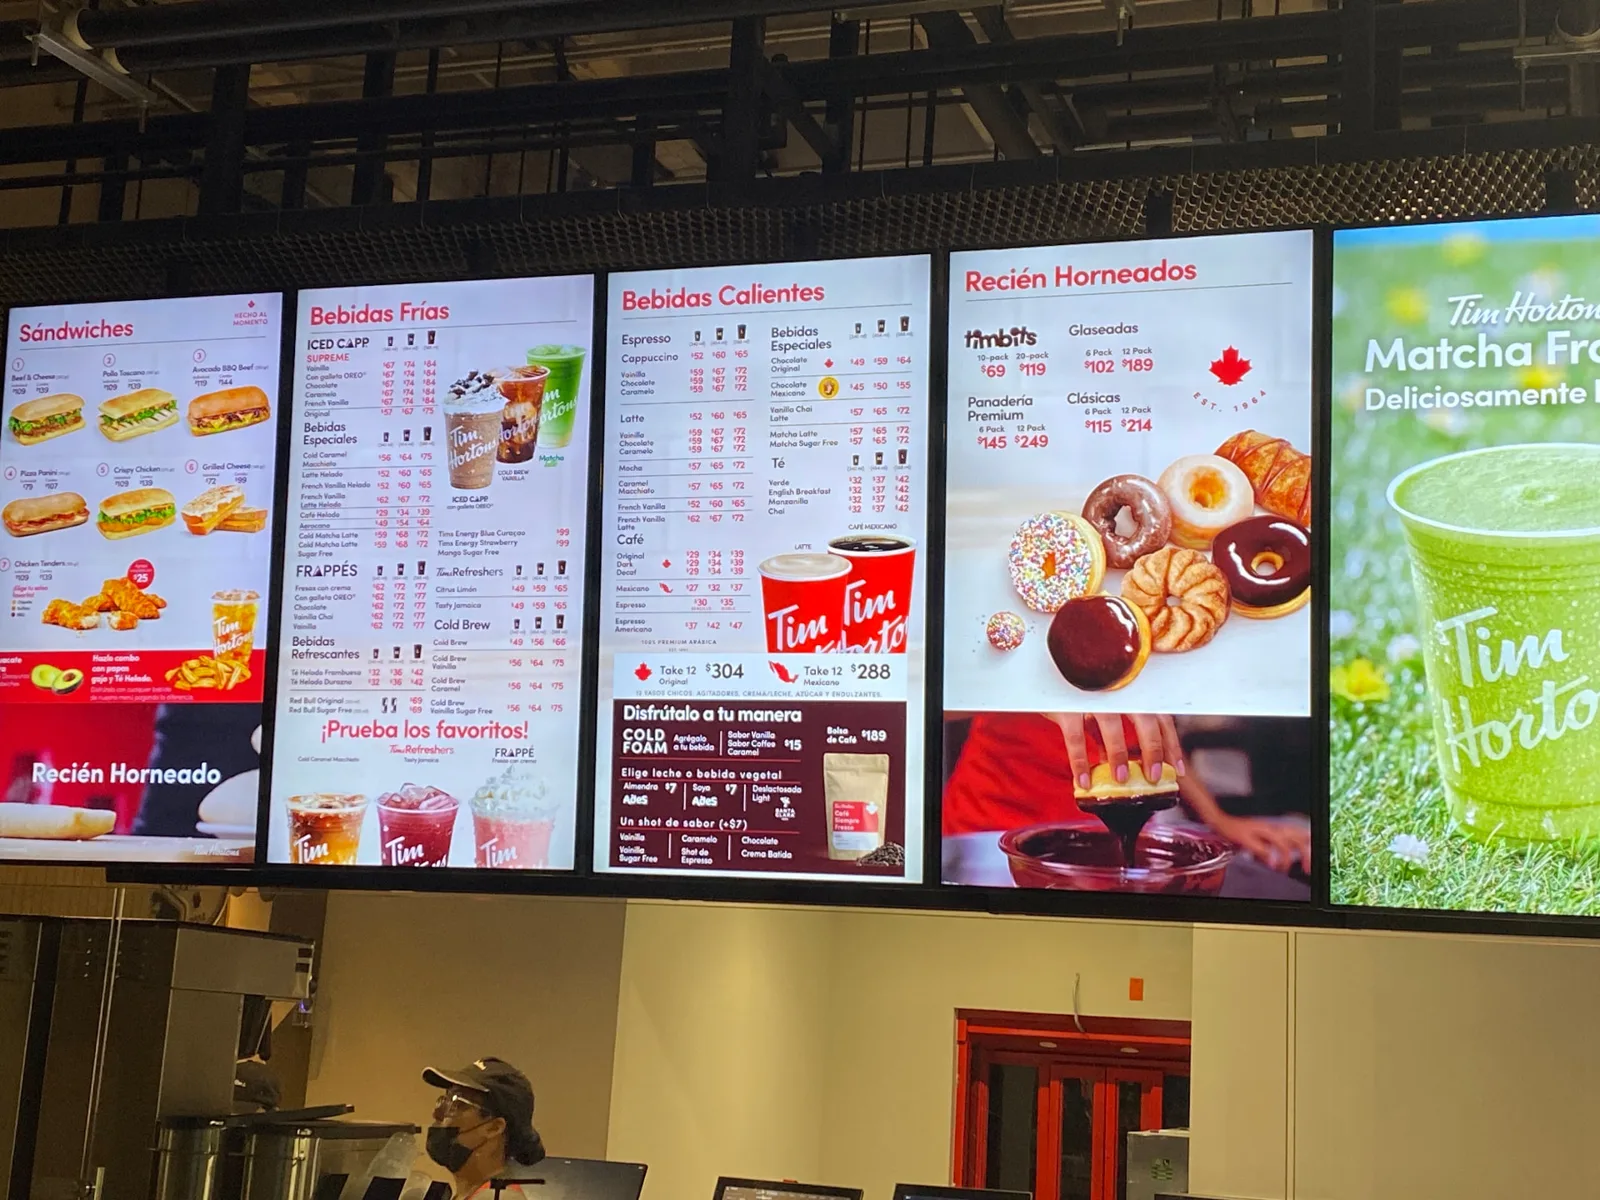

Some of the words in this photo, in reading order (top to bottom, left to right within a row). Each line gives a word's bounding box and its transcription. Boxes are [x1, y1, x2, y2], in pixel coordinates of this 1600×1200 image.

[965, 267, 1047, 292] Recién
[1055, 259, 1197, 287] Horneados
[623, 287, 712, 310] Bebidas
[719, 283, 826, 305] Calientes
[310, 303, 394, 325] Bebidas
[400, 300, 450, 321] Frías
[1448, 294, 1501, 326] Tim
[233, 318, 268, 326] MOMENTO
[19, 320, 134, 342] Sándwiches
[771, 326, 818, 338] Bebidas
[1069, 322, 1138, 336] Glaseadas
[622, 334, 671, 346] Espresso
[965, 326, 1037, 349] timbits
[308, 340, 334, 350] ICED
[771, 340, 832, 353] Especiales
[307, 353, 349, 362] SUPREME
[622, 353, 678, 365] Cappuccino
[691, 352, 704, 360] $52
[735, 350, 748, 358] $65
[977, 354, 1009, 362] 10-pack
[1016, 352, 1049, 360] 20-pack
[1365, 333, 1532, 372] Matcha
[851, 358, 865, 366] $49
[874, 357, 888, 365] $59
[897, 356, 911, 364] $64
[1084, 360, 1114, 374] $102
[1122, 358, 1153, 372] $189
[103, 369, 118, 377] Pollo
[192, 365, 221, 373] Avocado
[771, 365, 800, 373] Original
[981, 364, 1006, 378] $69
[1019, 362, 1046, 376] $119
[12, 374, 28, 382] Beef
[968, 394, 1033, 408] Panadería
[1067, 392, 1120, 405] Clásicas
[1365, 383, 1587, 411] Deliciosamente
[620, 415, 644, 423] Latte
[690, 412, 702, 420] $52
[968, 409, 1024, 421] Premium
[304, 422, 346, 433] Bebidas
[1085, 420, 1112, 433] $115
[1121, 419, 1152, 432] $214
[304, 434, 357, 447] Especiales
[977, 436, 1007, 449] $145
[1014, 434, 1049, 448] $249
[772, 457, 785, 468] Té
[20, 470, 36, 478] Pizza
[114, 466, 133, 474] Crispy
[769, 488, 794, 496] English
[617, 534, 644, 545] Café
[14, 560, 39, 568] Chicken
[296, 560, 358, 577] FRAPPÉS
[133, 574, 148, 582] $25
[214, 616, 240, 636] Tim
[434, 619, 459, 630] Cold
[462, 620, 490, 630] Brew
[768, 604, 828, 651] Tim
[292, 636, 335, 646] Bebidas
[1435, 606, 1570, 688] Tim
[291, 649, 359, 659] Refrescantes
[660, 666, 684, 675] Take
[686, 666, 696, 675] 12
[706, 663, 744, 678] $304
[804, 666, 829, 676] Take
[833, 666, 842, 675] 12
[851, 664, 890, 679] $288
[659, 678, 688, 686] Original
[624, 704, 700, 721] Disfrútalo
[703, 710, 714, 720] a
[718, 706, 734, 721] tu
[738, 705, 803, 722] manera
[321, 720, 398, 743] ¡Prueba
[404, 720, 430, 739] los
[437, 720, 528, 739] favoritos!
[622, 728, 665, 740] COLD
[827, 726, 848, 734] Bolsa
[862, 730, 887, 741] $189
[623, 742, 668, 754] FOAM
[784, 739, 802, 750] $15
[495, 746, 535, 758] FRAPPÉ
[32, 762, 104, 784] Recién
[110, 762, 221, 784] Horneado
[621, 768, 648, 779] Elige
[652, 768, 682, 777] leche
[686, 770, 692, 778] o
[697, 768, 735, 778] bebida
[740, 770, 782, 782] vegetal
[620, 816, 634, 825] Un
[638, 817, 661, 826] shot
[666, 817, 679, 827] de
[683, 819, 715, 828] sabor
[719, 819, 748, 831] (+$7)
[293, 834, 329, 866] Tim
[385, 836, 424, 867] Tim
[480, 837, 517, 868] Tim
